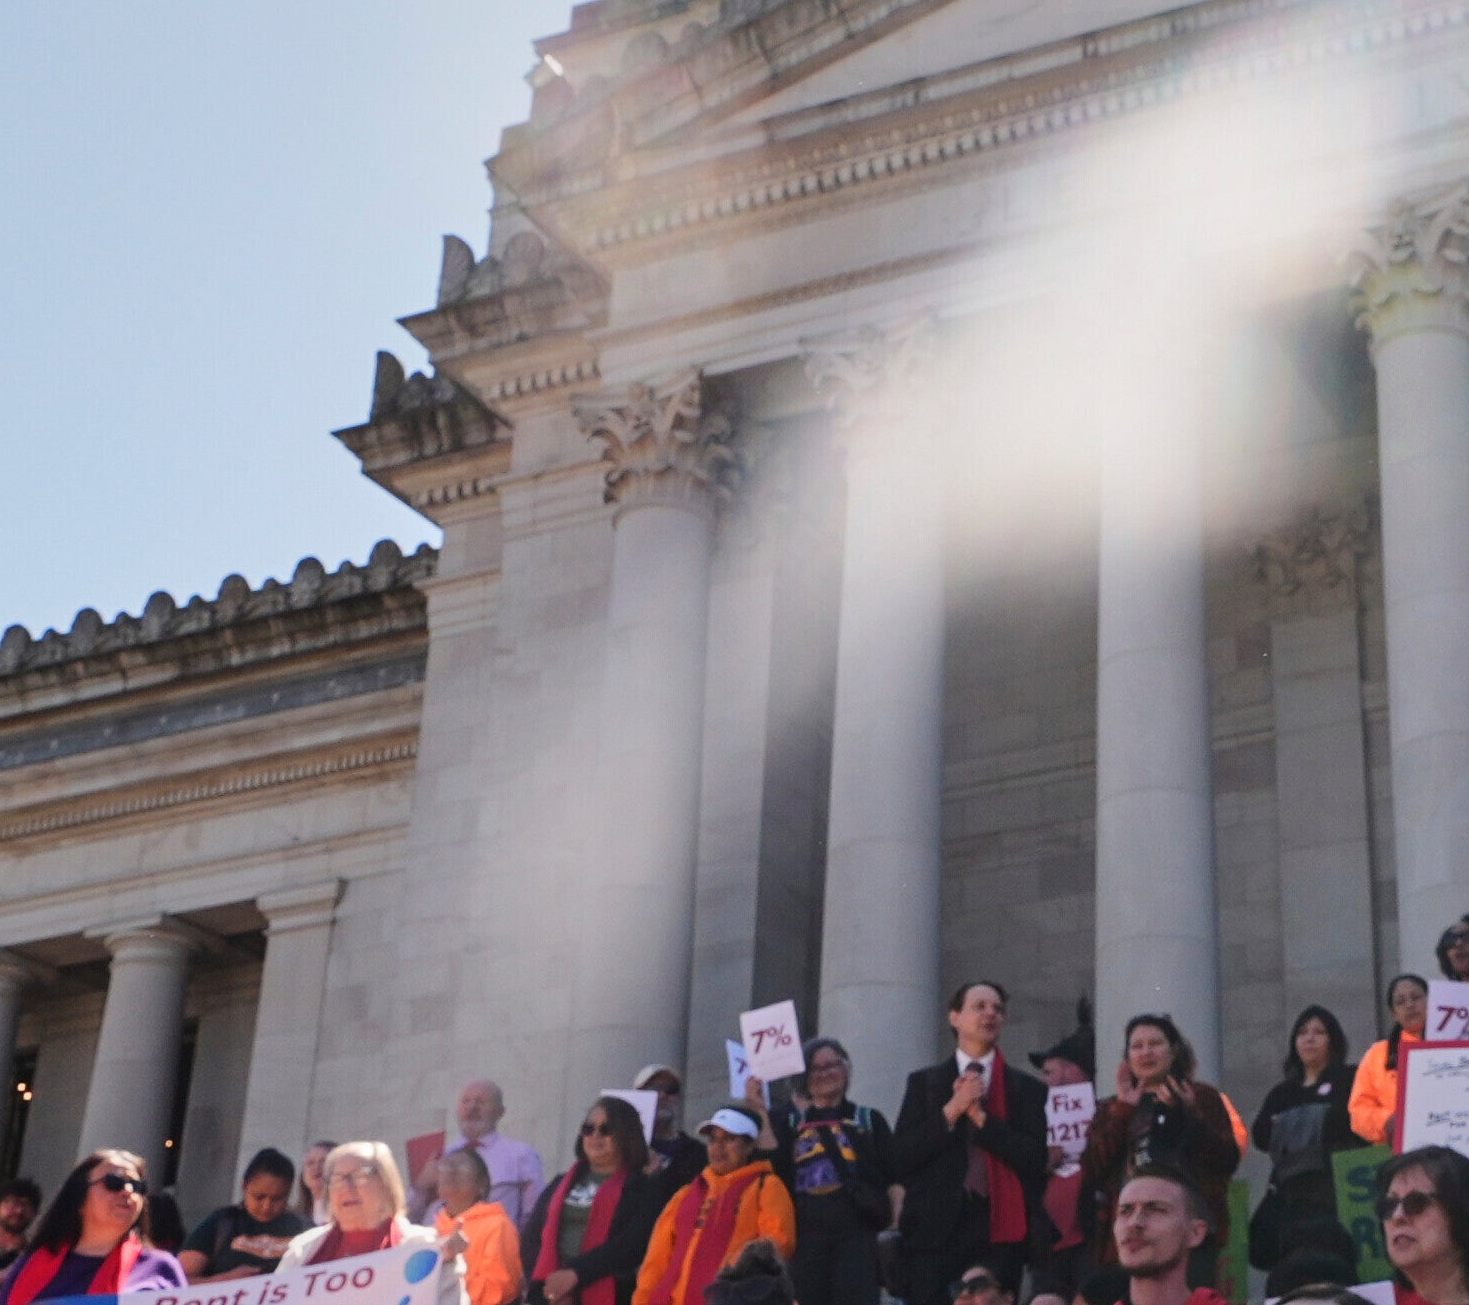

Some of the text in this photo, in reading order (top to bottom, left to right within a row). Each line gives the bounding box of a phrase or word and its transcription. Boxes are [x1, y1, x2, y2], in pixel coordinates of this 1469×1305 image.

[750, 1023, 793, 1055] 7%
[1052, 1094, 1084, 1114] Fix
[303, 1265, 376, 1298] Too
